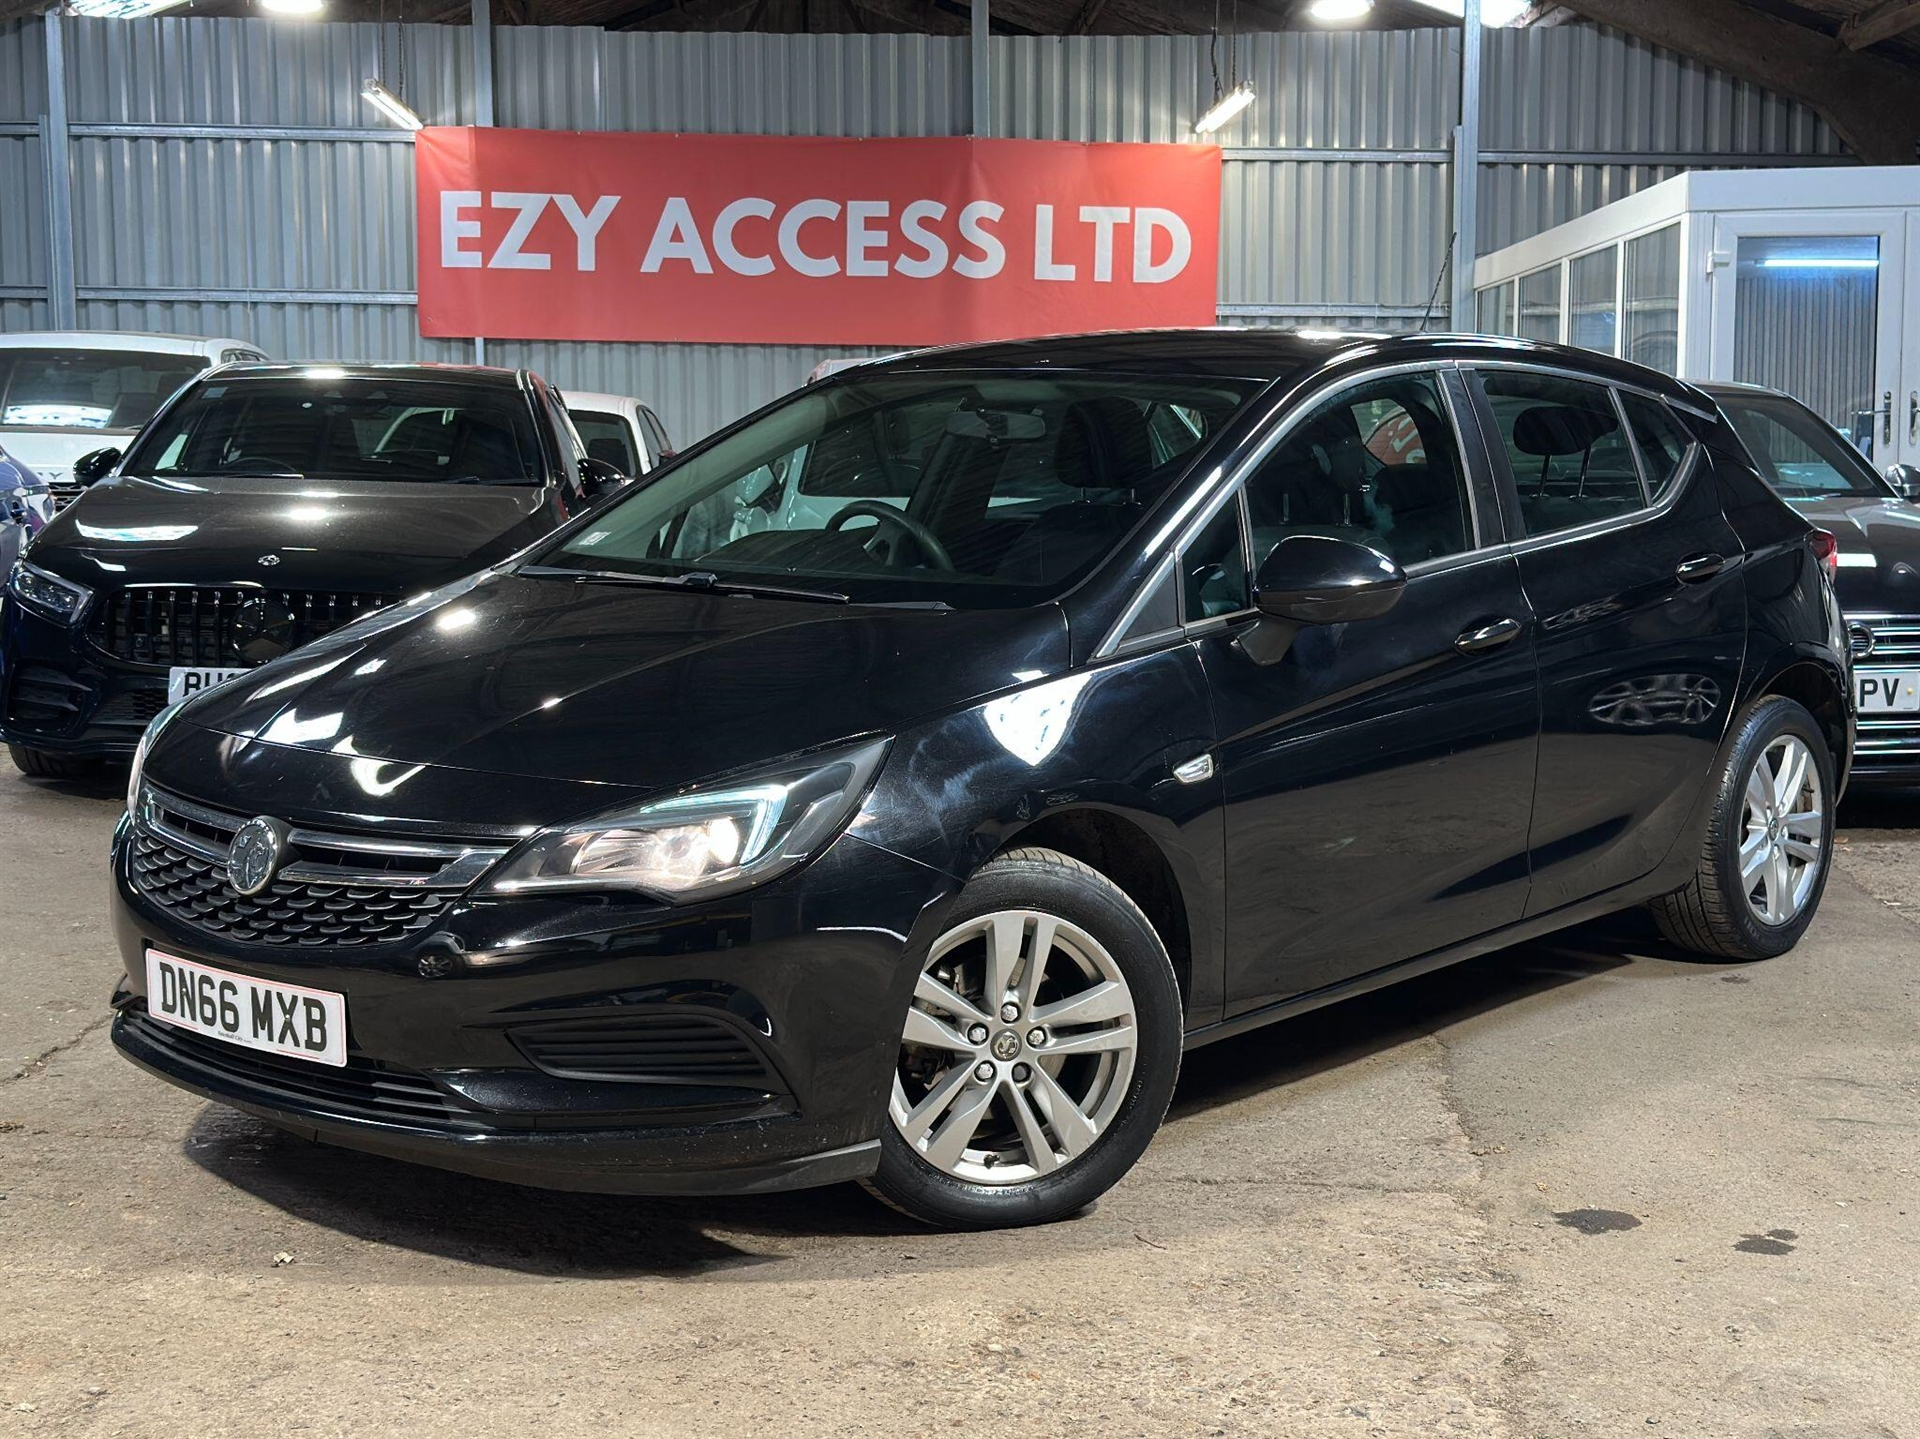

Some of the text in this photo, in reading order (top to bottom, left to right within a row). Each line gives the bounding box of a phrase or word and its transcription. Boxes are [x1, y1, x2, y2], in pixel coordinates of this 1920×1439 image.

[440, 190, 1192, 283] EZY ACCESS LTD
[159, 961, 327, 1052] DN66 MXB
